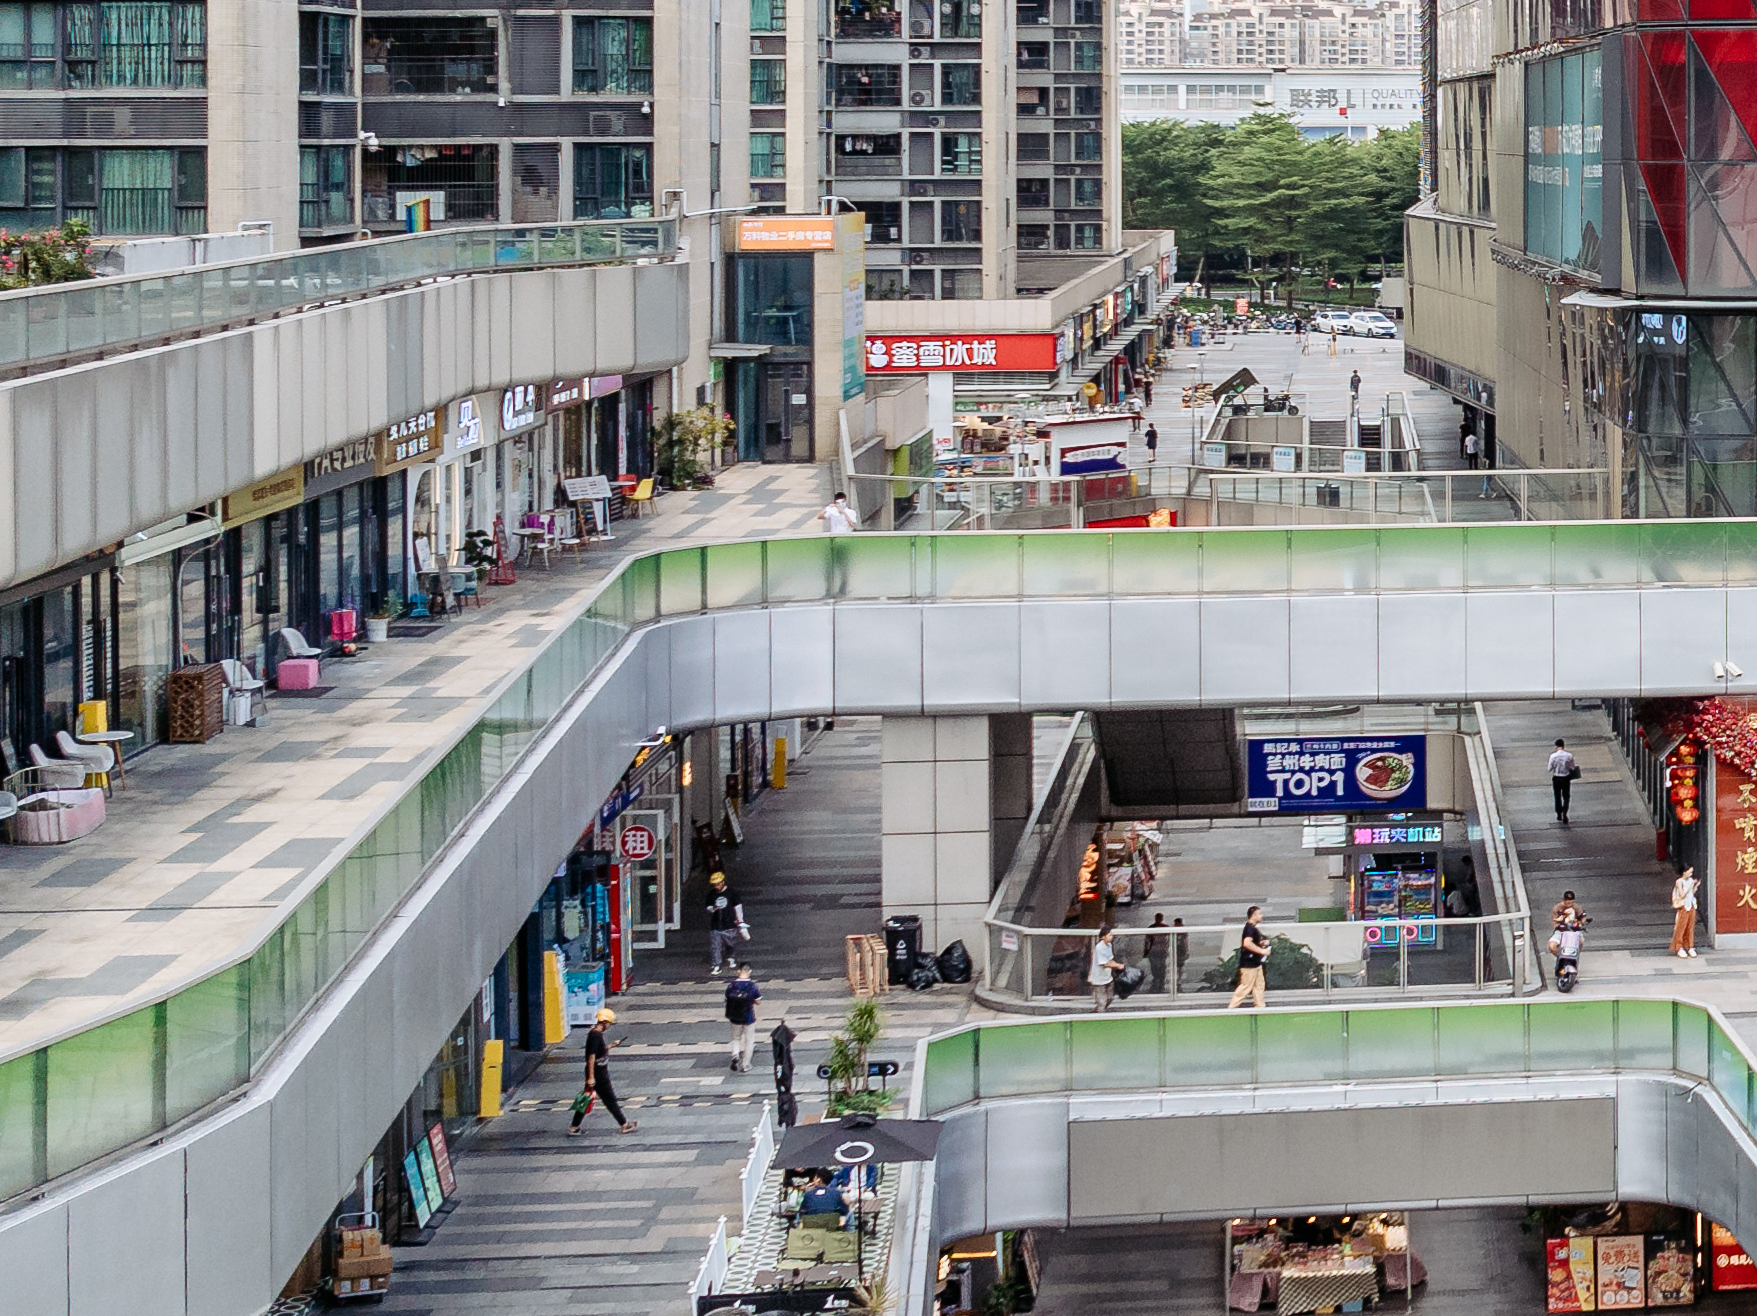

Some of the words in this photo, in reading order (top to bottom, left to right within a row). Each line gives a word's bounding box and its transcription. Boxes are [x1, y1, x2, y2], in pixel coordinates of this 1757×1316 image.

[1371, 88, 1423, 100] QUALITY
[890, 340, 997, 367] 蜜雪冰城
[1266, 753, 1347, 771] 兰州牛肉面
[1266, 771, 1346, 797] TOP1
[623, 830, 651, 856] 租
